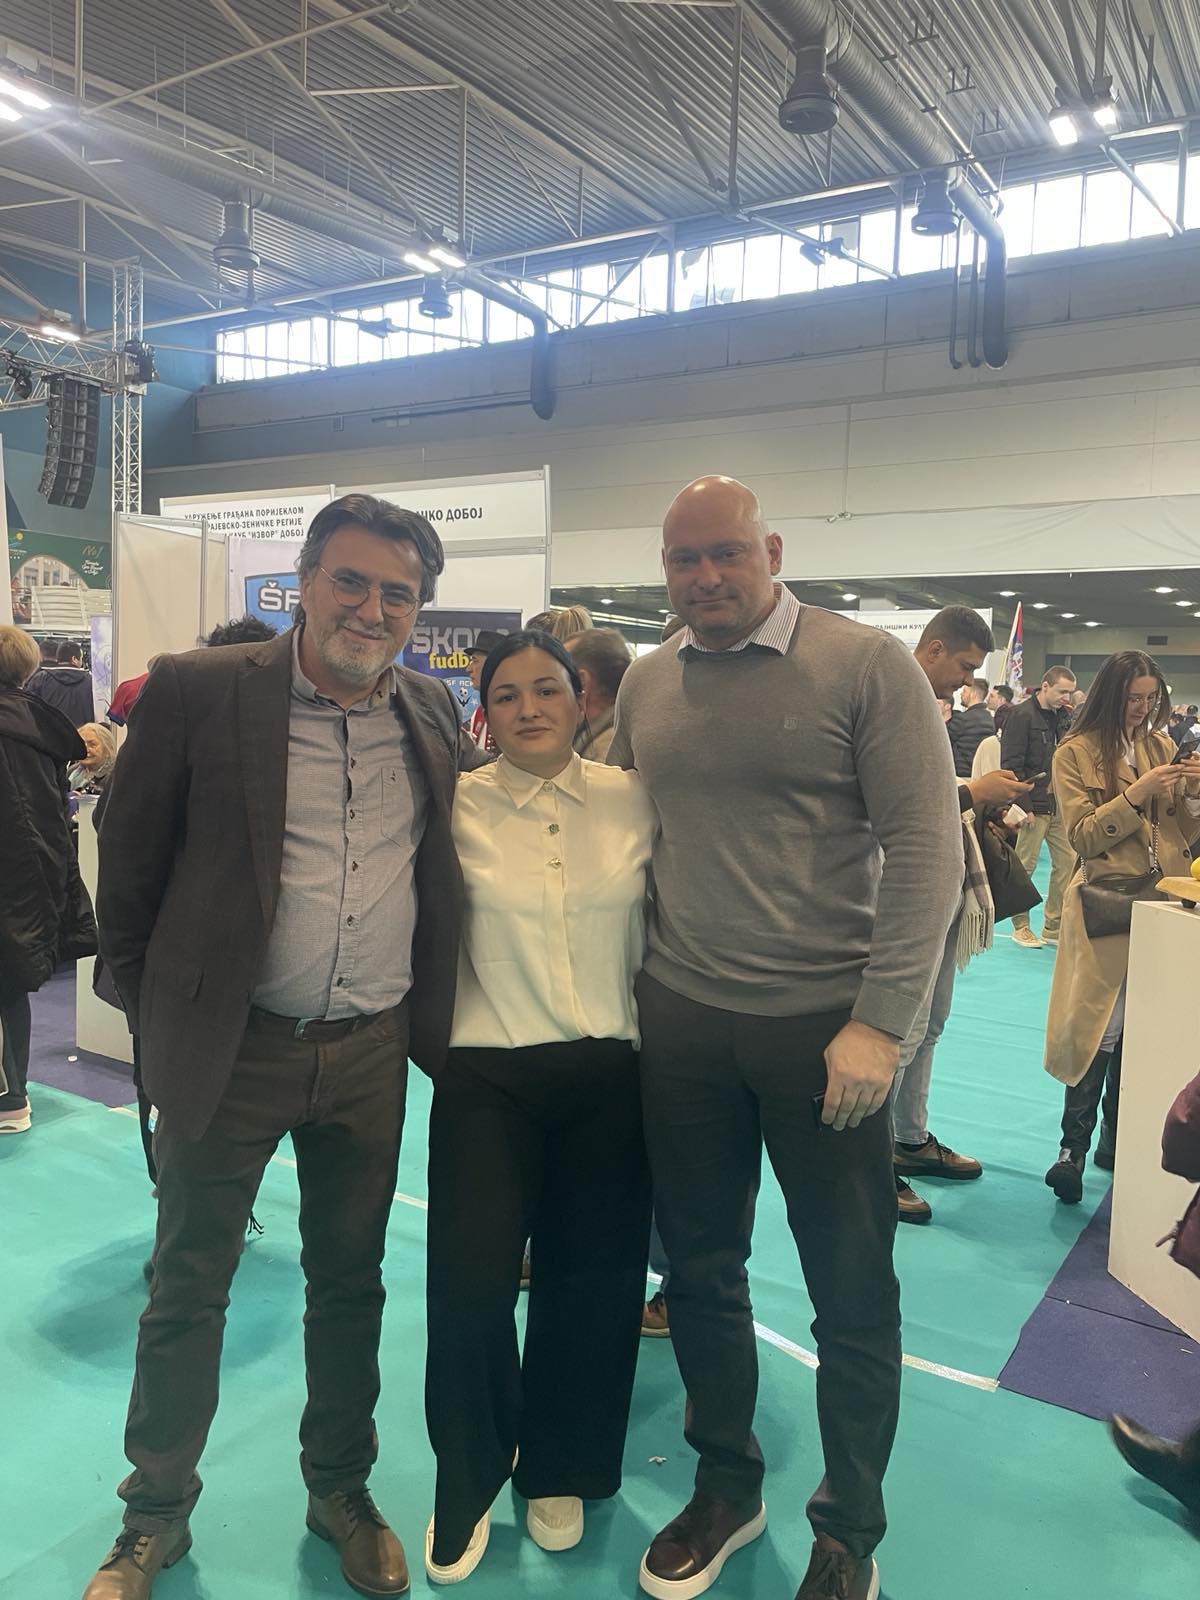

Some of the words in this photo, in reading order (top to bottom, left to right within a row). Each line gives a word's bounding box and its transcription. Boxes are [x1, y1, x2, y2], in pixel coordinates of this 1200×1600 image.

[223, 509, 254, 520] ГРАЂАНА
[255, 506, 304, 517] ПОРИЈЕКЛОМ
[445, 507, 483, 523] ДОБОЈ
[276, 517, 302, 527] РЕГИЈЕ
[248, 530, 278, 539] "ИЗВОР"
[280, 529, 304, 539] ДОБОЈ
[429, 651, 473, 670] fudb
